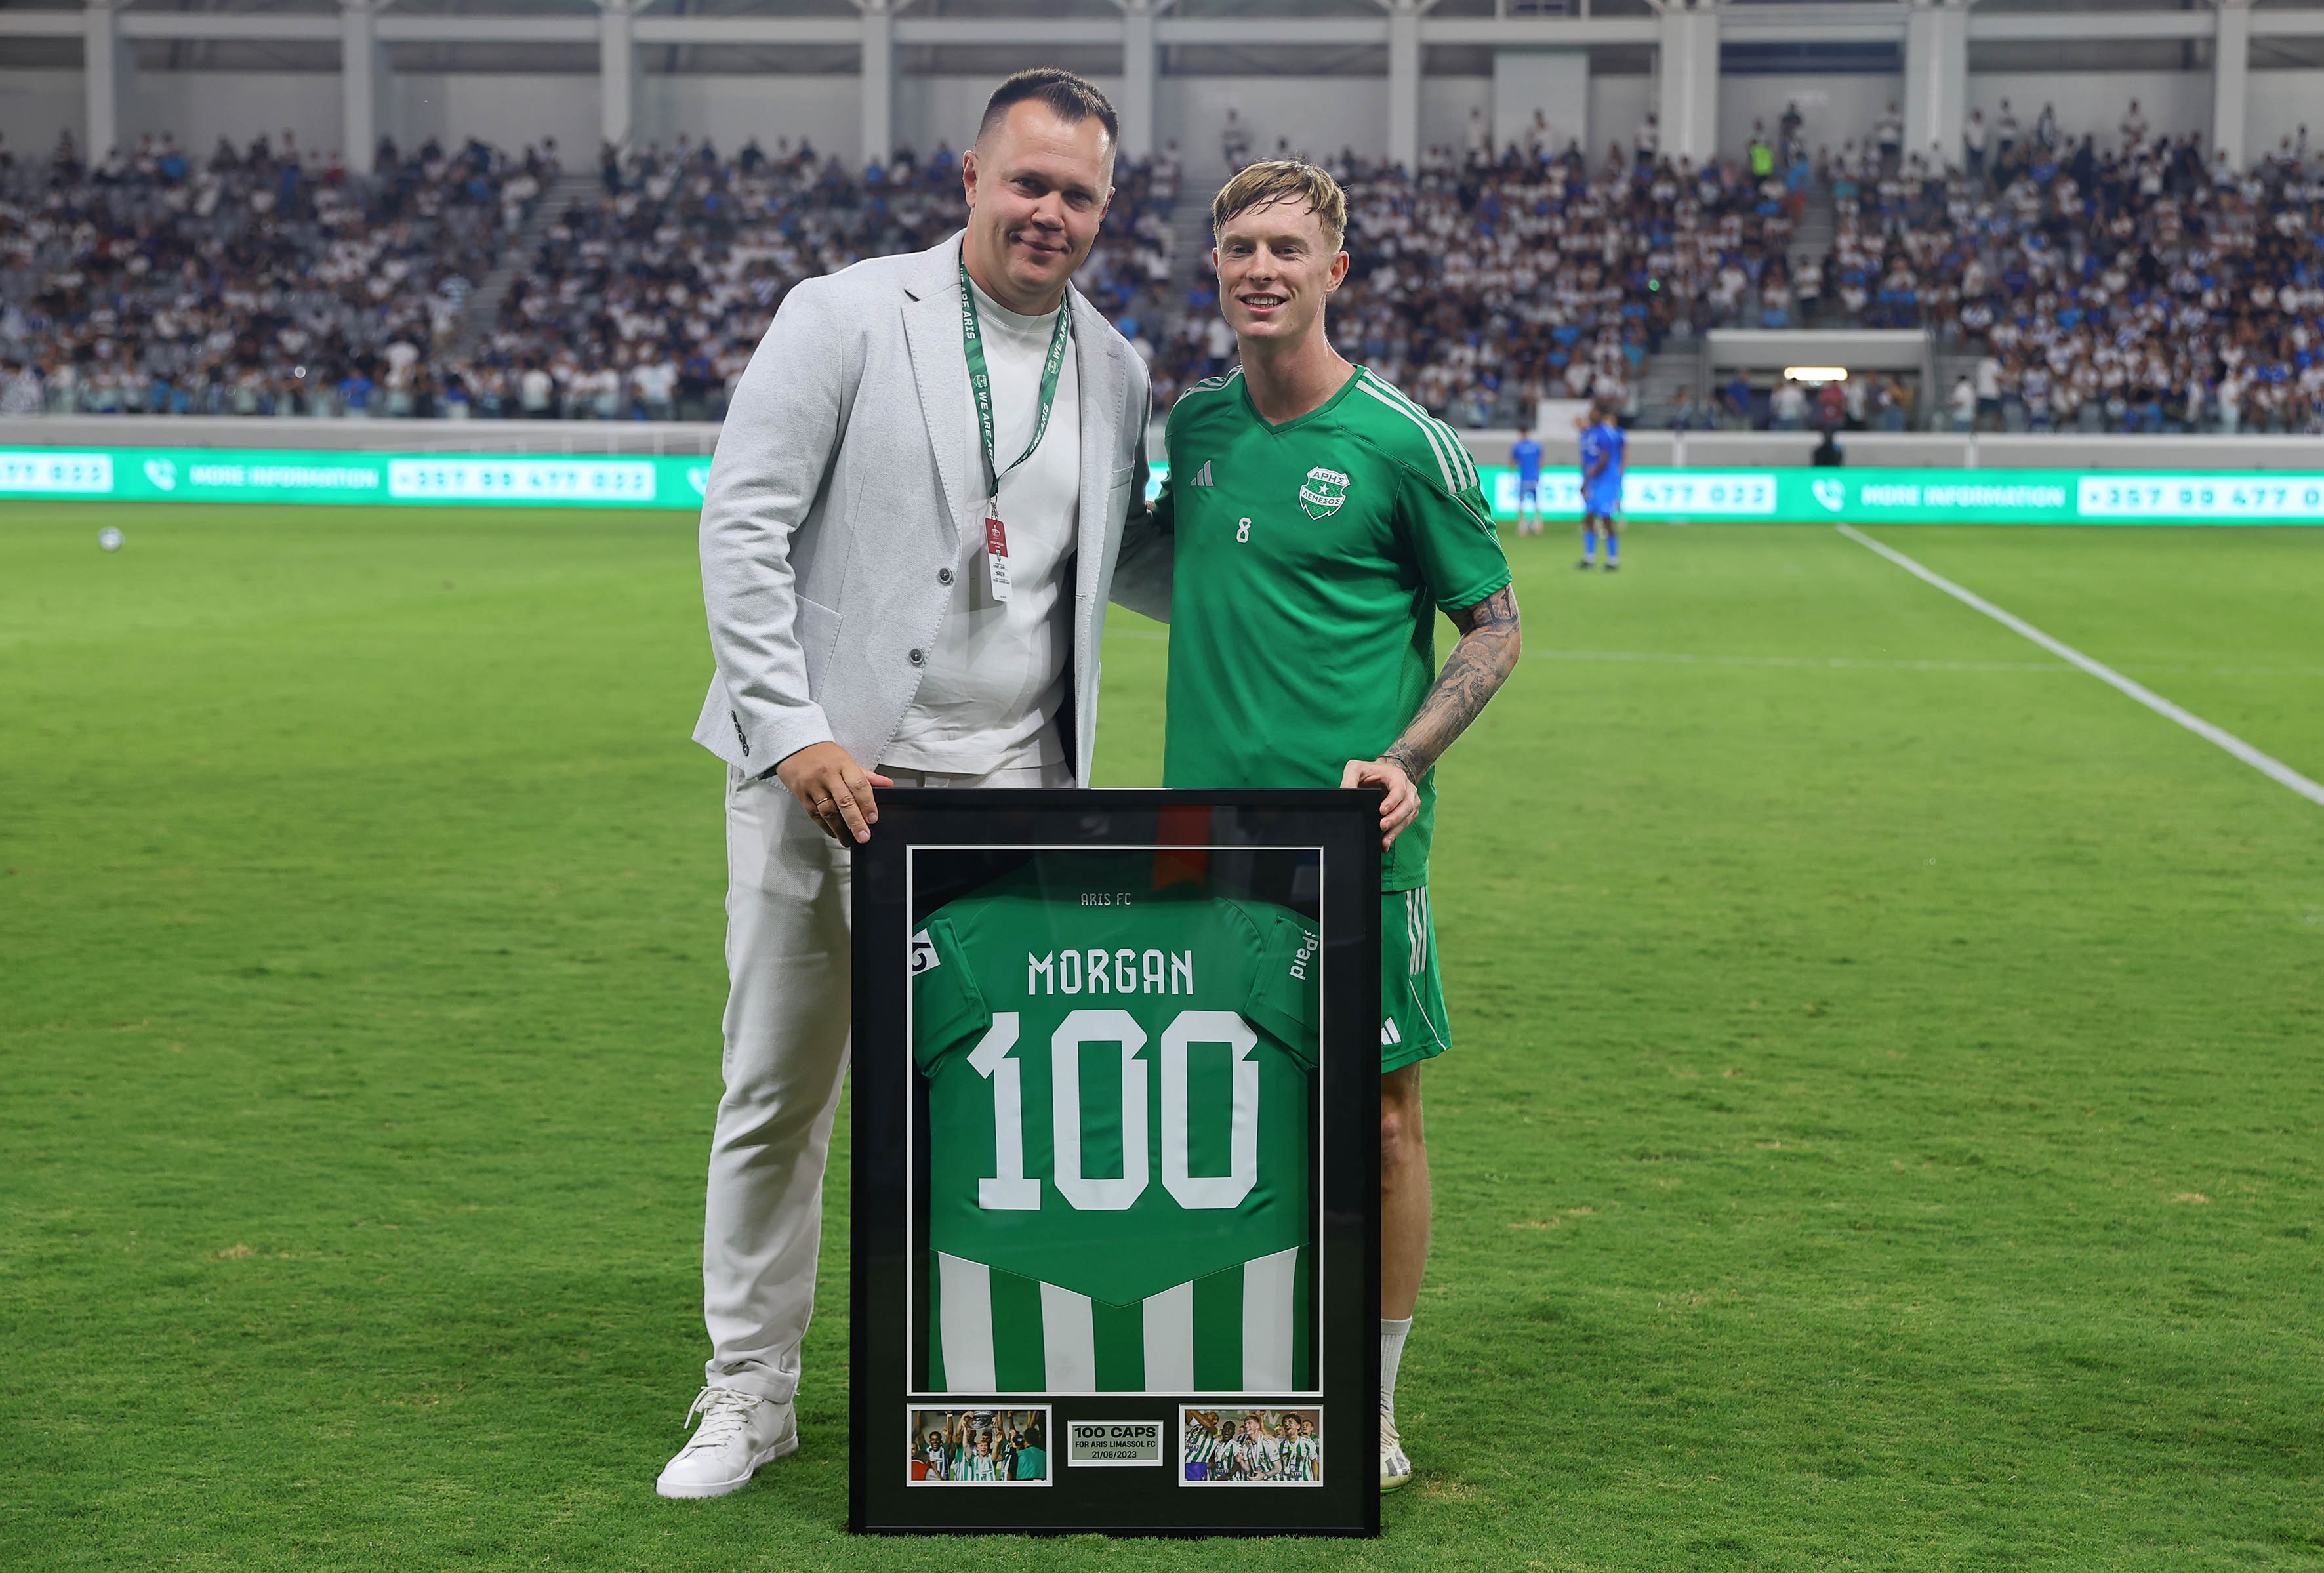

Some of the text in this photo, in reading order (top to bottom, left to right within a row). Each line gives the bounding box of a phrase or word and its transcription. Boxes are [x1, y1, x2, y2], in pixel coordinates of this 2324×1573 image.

[962, 310, 976, 339] ARIS
[1053, 340, 1063, 359] WE
[978, 392, 989, 410] WE
[982, 411, 992, 438] ARE
[1040, 402, 1049, 433] ARIS
[987, 439, 995, 466] AR
[1313, 472, 1344, 485] ΑΡΗΣ
[1303, 491, 1340, 504] ΛΕΜΕΣΟΣ
[1862, 485, 2066, 507] MORE INFORMATION
[1236, 517, 1252, 543] 8
[1081, 893, 1131, 906] ARIS FC
[1028, 949, 1193, 995] MORGAN
[966, 1009, 1259, 1210] 100
[1074, 1427, 1156, 1439] 100 CAPS
[1091, 1450, 1137, 1460] 21/08/2023
